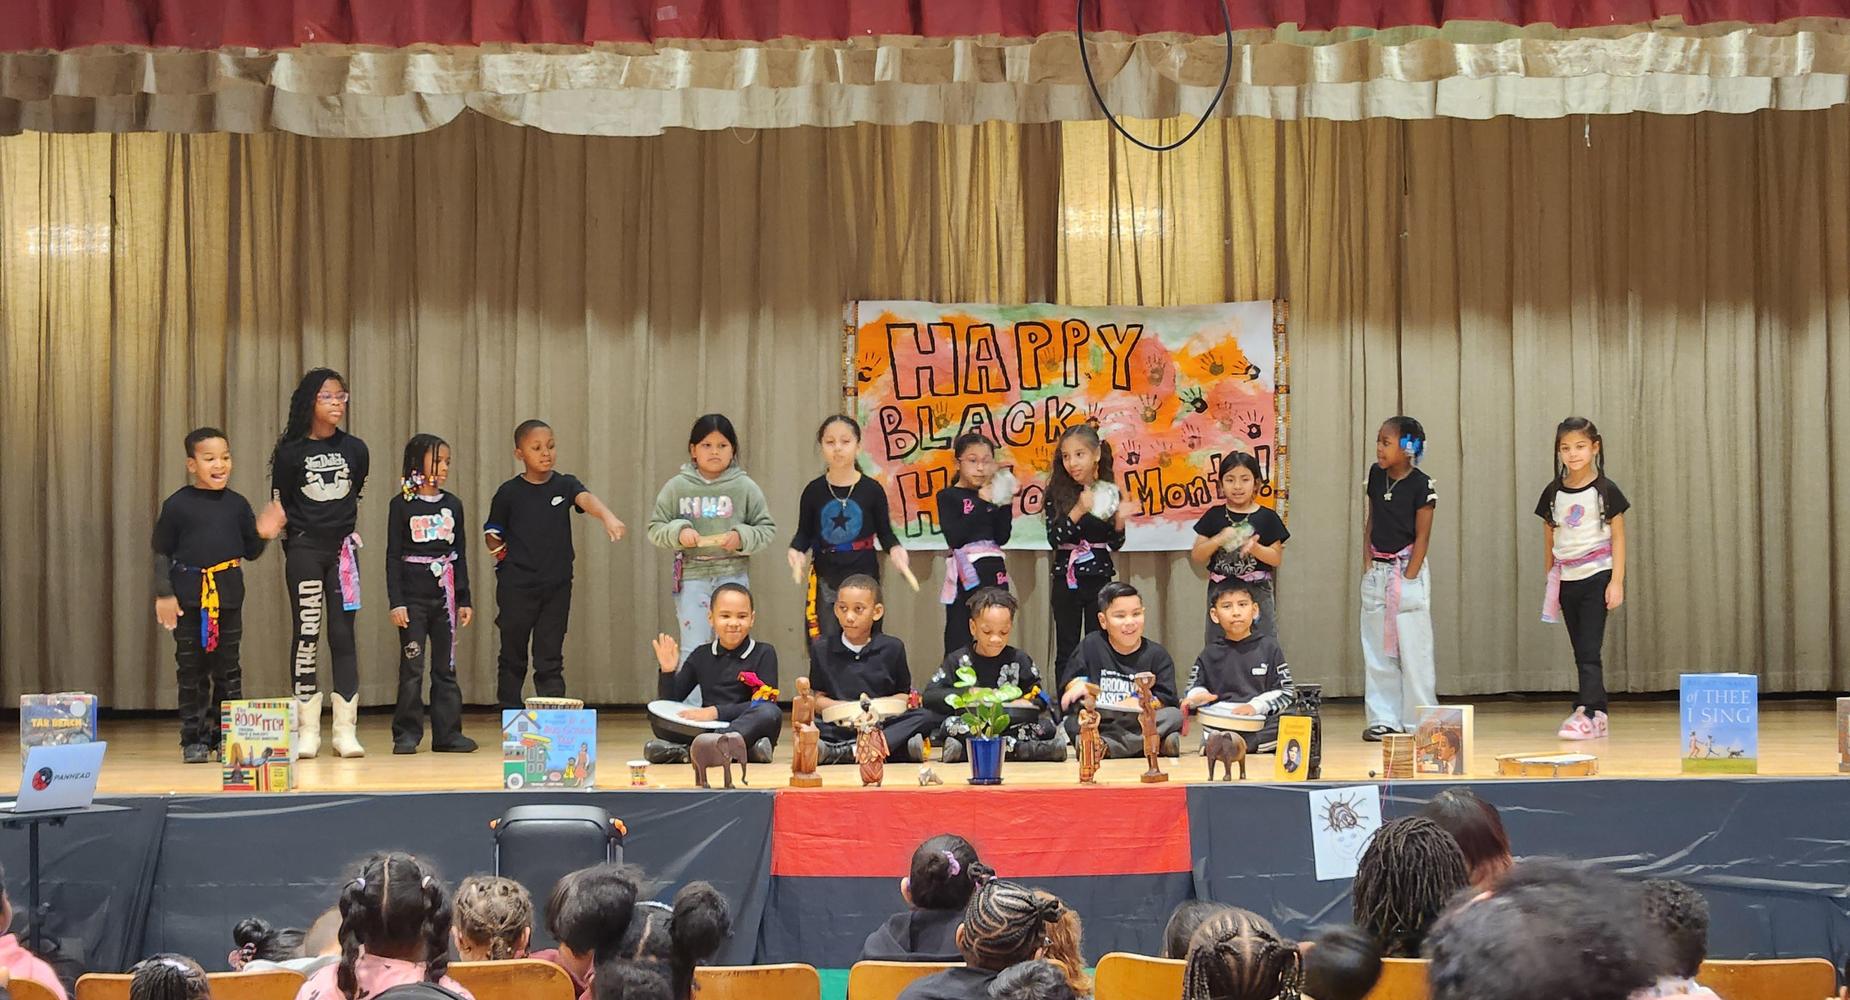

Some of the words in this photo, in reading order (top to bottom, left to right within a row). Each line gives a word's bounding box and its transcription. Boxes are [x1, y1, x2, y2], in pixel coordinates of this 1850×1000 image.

[886, 318, 1144, 399] HAPPY
[879, 396, 1077, 461] BLACK
[1124, 444, 1272, 516] Mont!
[679, 495, 734, 518] KIND
[298, 580, 323, 636] ROAD
[295, 640, 318, 677] THE
[1686, 689, 1699, 707] of
[1703, 689, 1751, 705] THEE
[235, 713, 262, 727] BOOK
[262, 719, 284, 731] ITCH
[1687, 707, 1693, 723] I
[1701, 707, 1751, 723] SING
[54, 771, 91, 781] PANHEAD
